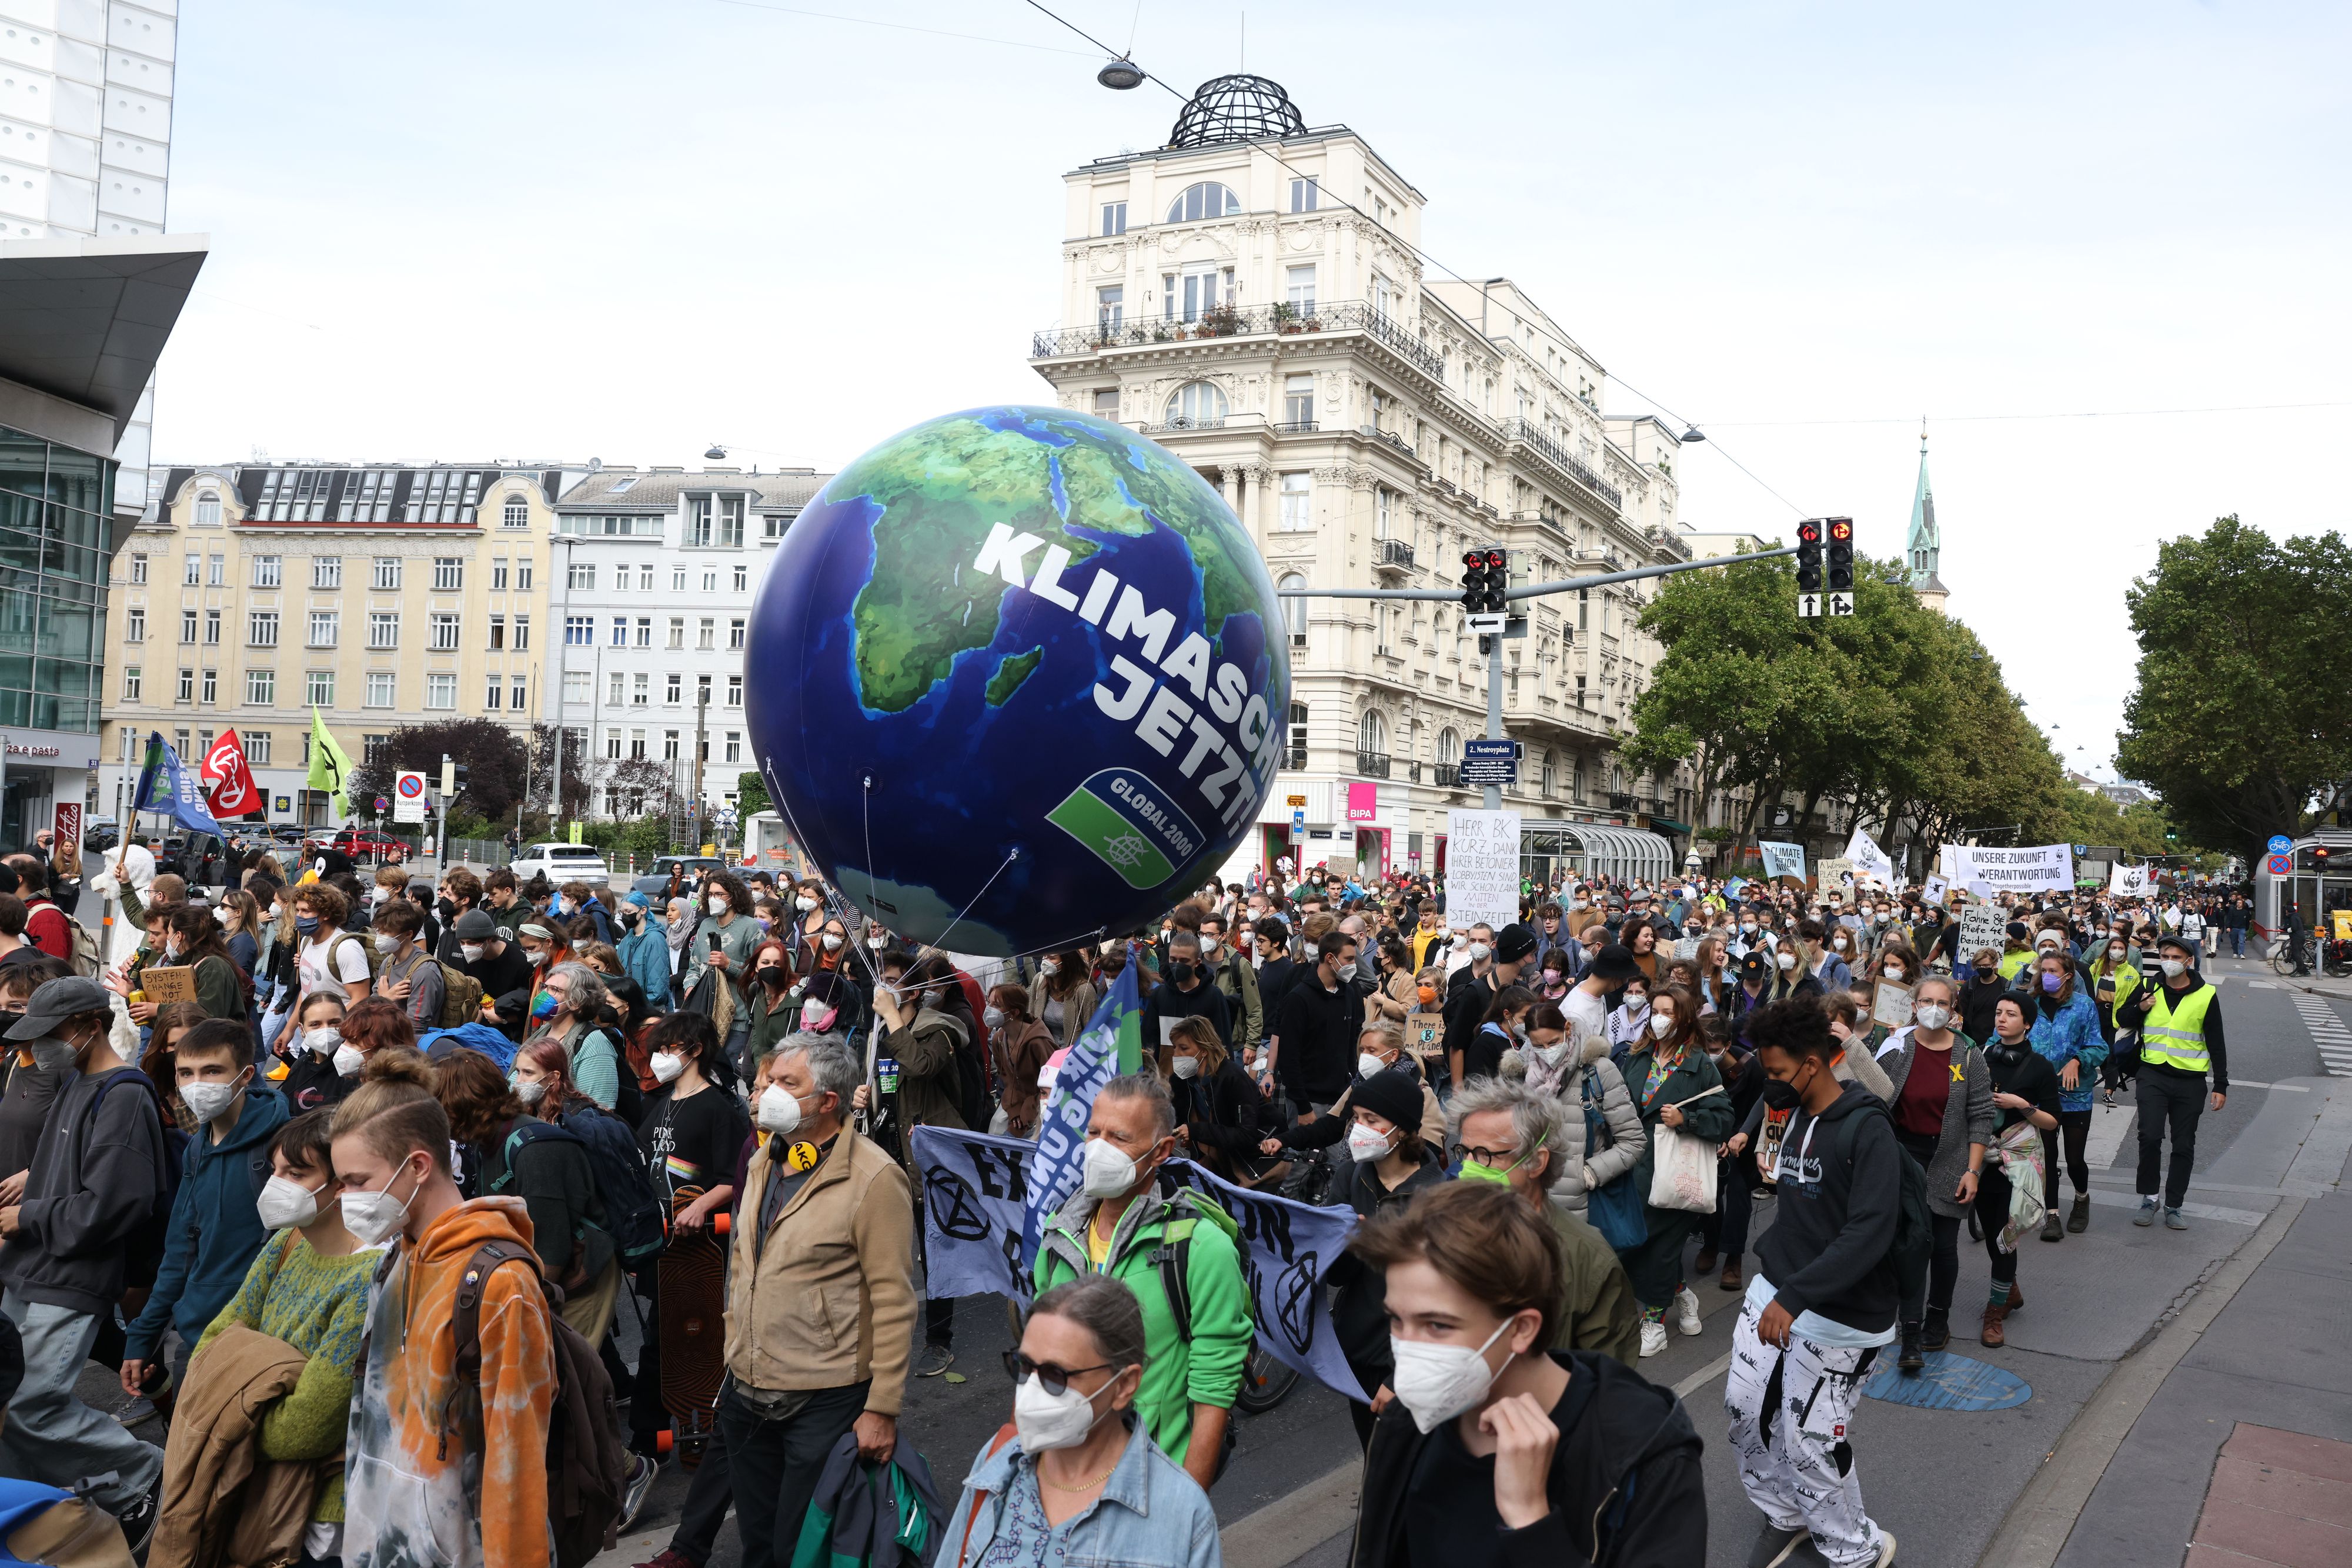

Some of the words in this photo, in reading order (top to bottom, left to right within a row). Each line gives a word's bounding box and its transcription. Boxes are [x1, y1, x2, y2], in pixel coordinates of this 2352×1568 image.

[31, 745, 59, 757] pasta
[1093, 654, 1258, 838] JETZT!
[1476, 745, 1510, 755] Nestroyplatz
[153, 791, 175, 800] Klima
[1110, 777, 1168, 832] GLOBAL
[1163, 824, 1193, 857] 2000
[1350, 809, 1372, 818] BIPA
[58, 805, 78, 841] talico
[1455, 817, 1484, 837] HERR
[1493, 818, 1511, 839] BK
[1453, 838, 1490, 856] KURZ,
[1494, 842, 1518, 855] DANK
[1771, 847, 1800, 859] CLIMATE
[1452, 855, 1473, 868] IHRER
[1475, 857, 1516, 870] BETONIER-
[1972, 852, 2006, 864] UNSERE
[2008, 851, 2047, 864] ZUKUNFT
[1826, 860, 1852, 870] WOMAN'S
[1452, 870, 1496, 881] LOBBYISTEN
[1498, 872, 1517, 882] SIND
[1820, 870, 1839, 878] PLACE
[1451, 881, 1466, 890] WIR
[1470, 882, 1498, 892] SCHON
[1499, 884, 1519, 892] LANG
[1464, 892, 1499, 903] MITTEN
[1449, 909, 1512, 924] "STEINZEIT"
[1964, 910, 1989, 924] Fahne
[1993, 914, 2005, 927] 8€
[1962, 923, 1986, 934] Pfeife
[1990, 926, 2003, 935] 4€
[1960, 934, 1989, 946] Beides
[1992, 938, 2004, 948] 10€
[145, 971, 186, 984] SYSTEM-
[147, 982, 183, 992] CHANGE
[162, 991, 182, 999] NOT
[1412, 1019, 1436, 1029] There
[1438, 1020, 1446, 1029] is
[1425, 1029, 1432, 1041] B
[653, 1127, 674, 1139] PINK
[652, 1141, 676, 1152] LOYD
[795, 1143, 812, 1171] AKG
[1780, 1157, 1820, 1171] ormance
